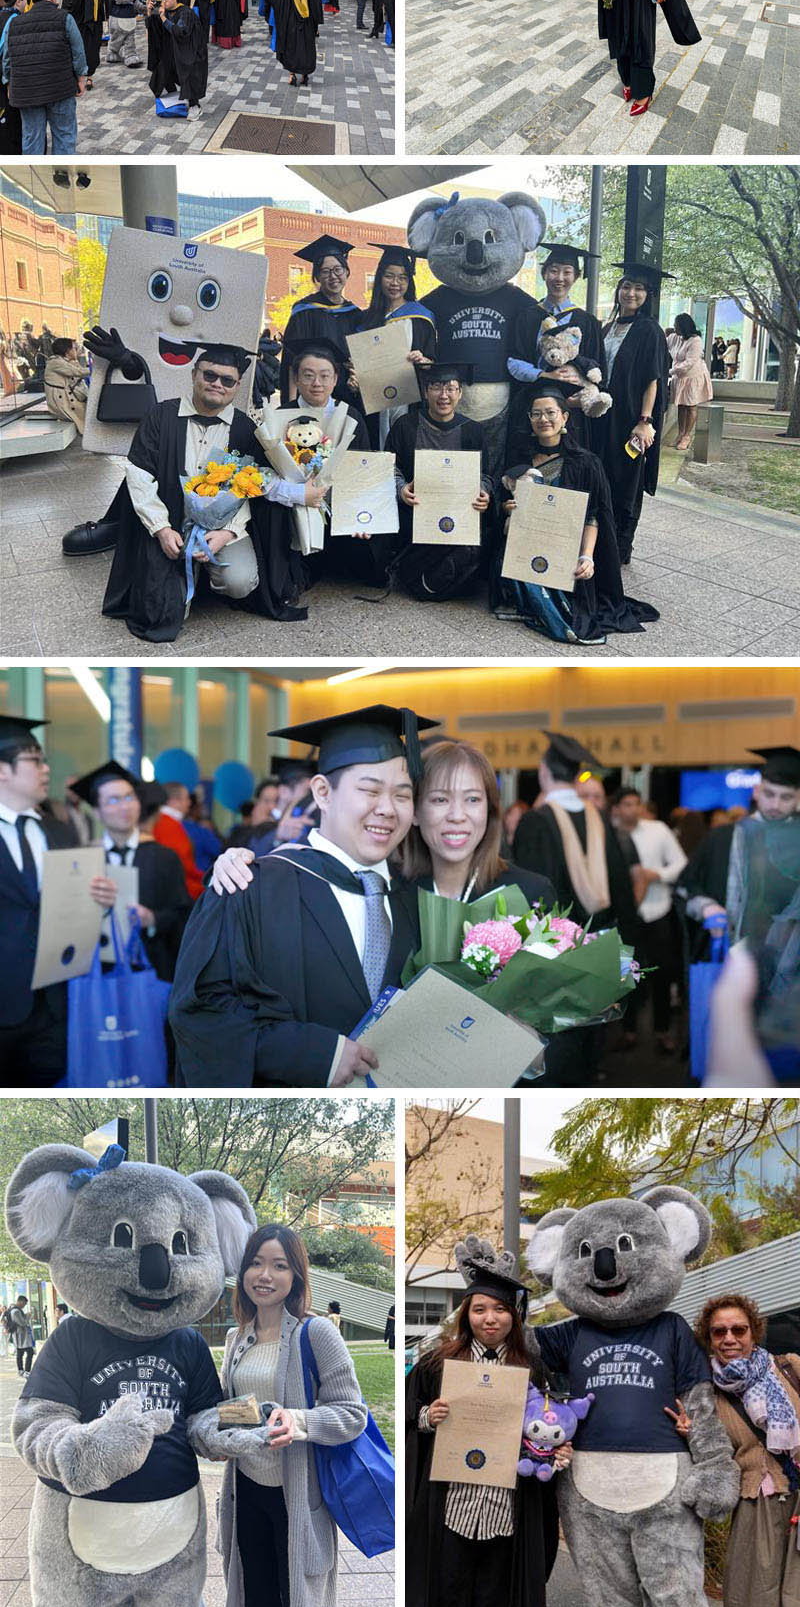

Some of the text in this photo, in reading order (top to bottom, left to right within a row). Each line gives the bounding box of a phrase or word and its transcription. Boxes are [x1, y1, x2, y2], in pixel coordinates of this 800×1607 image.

[449, 307, 505, 324] UNIVERSITY
[462, 320, 492, 329] SOUTH
[452, 329, 501, 340] AUSTRALIA
[582, 1344, 664, 1367] UNIVERSITY
[613, 1353, 627, 1361] OF
[90, 1355, 186, 1387] UNIVERSITY
[138, 1368, 153, 1379] OF
[598, 1362, 641, 1374] SOUTH
[585, 1374, 655, 1389] AUSTRALIA
[119, 1381, 170, 1397] SOUTH
